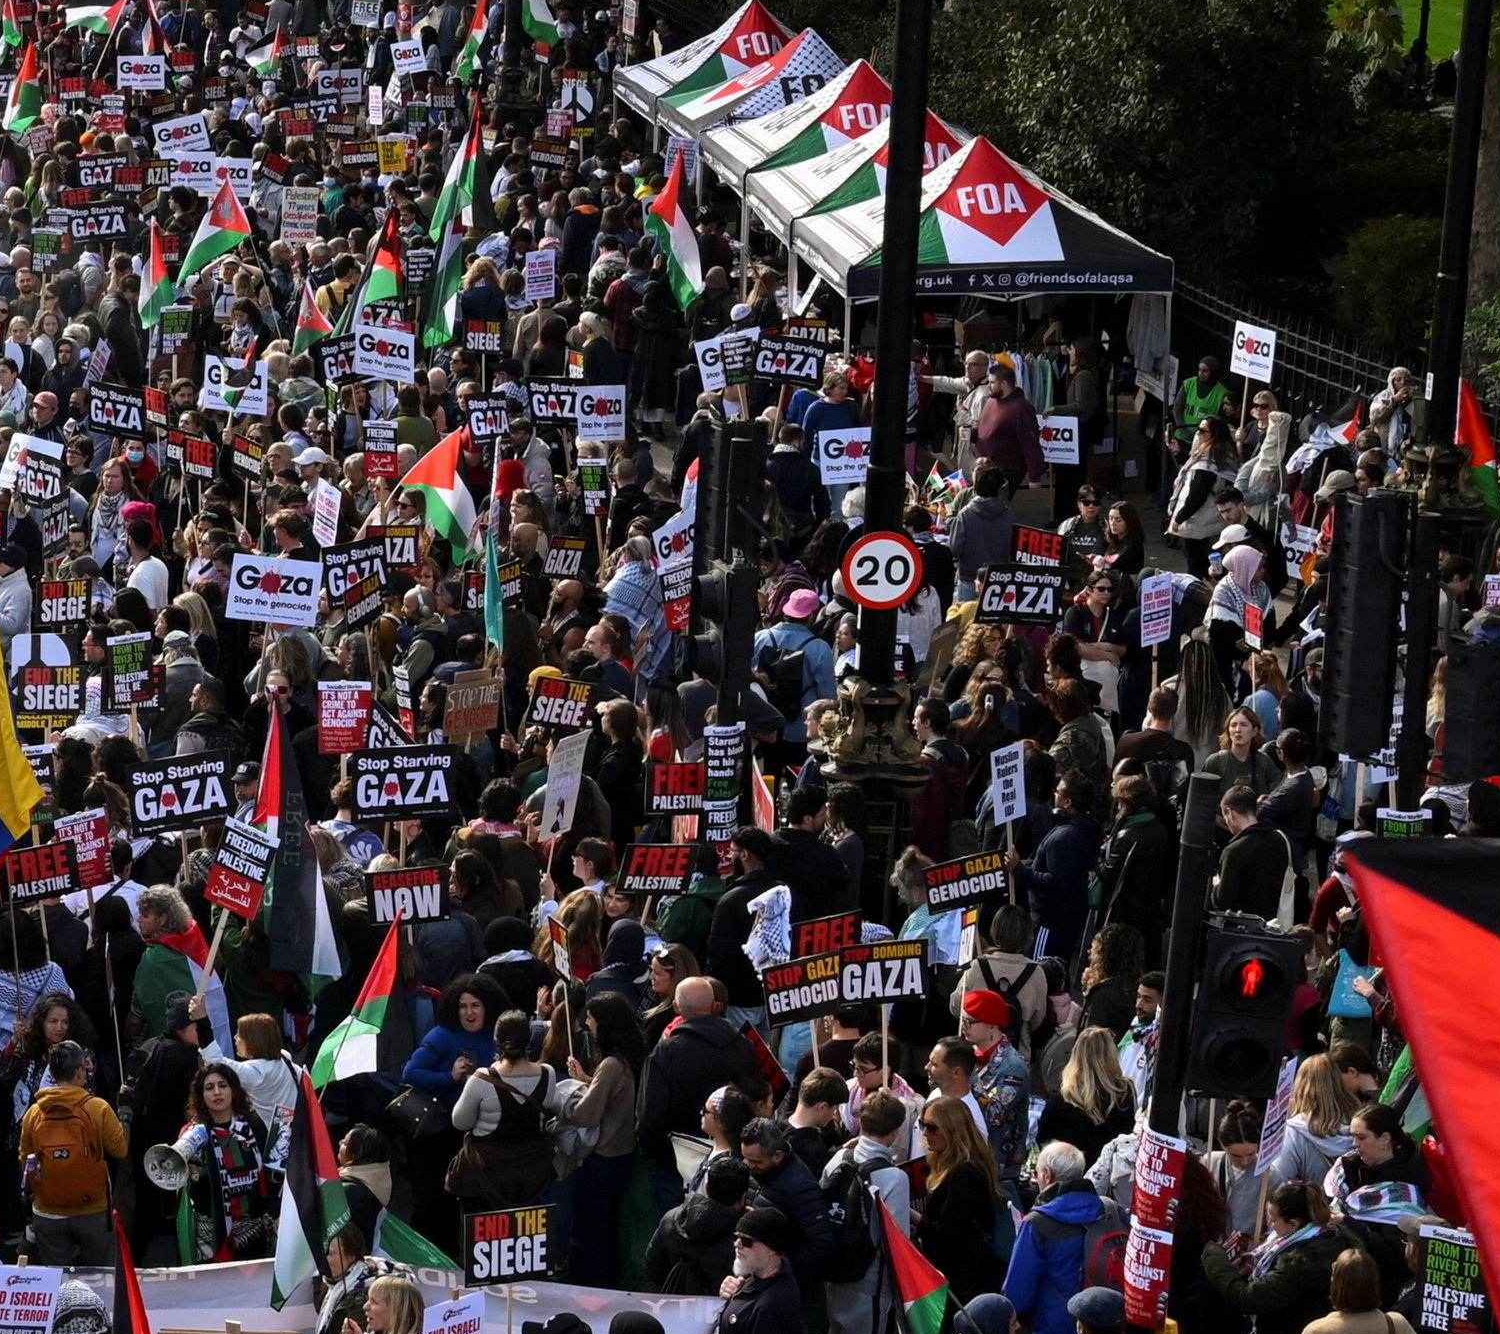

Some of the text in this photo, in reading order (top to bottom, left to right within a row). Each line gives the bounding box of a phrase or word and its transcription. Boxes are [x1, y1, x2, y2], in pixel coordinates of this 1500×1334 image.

[285, 189, 319, 201] Palestine
[957, 182, 1027, 218] FOA
[1014, 272, 1134, 287] @friendsofalaqsa
[236, 564, 315, 597] Gza
[856, 554, 911, 587] 20
[234, 596, 313, 612] Stop the genocide
[357, 753, 452, 773] Stop Starving
[356, 771, 450, 808] GAZA
[373, 869, 441, 890] CEASEFIRE
[374, 883, 441, 923] NOW
[473, 1208, 547, 1242] END THE
[473, 1235, 548, 1279] SIEGE
